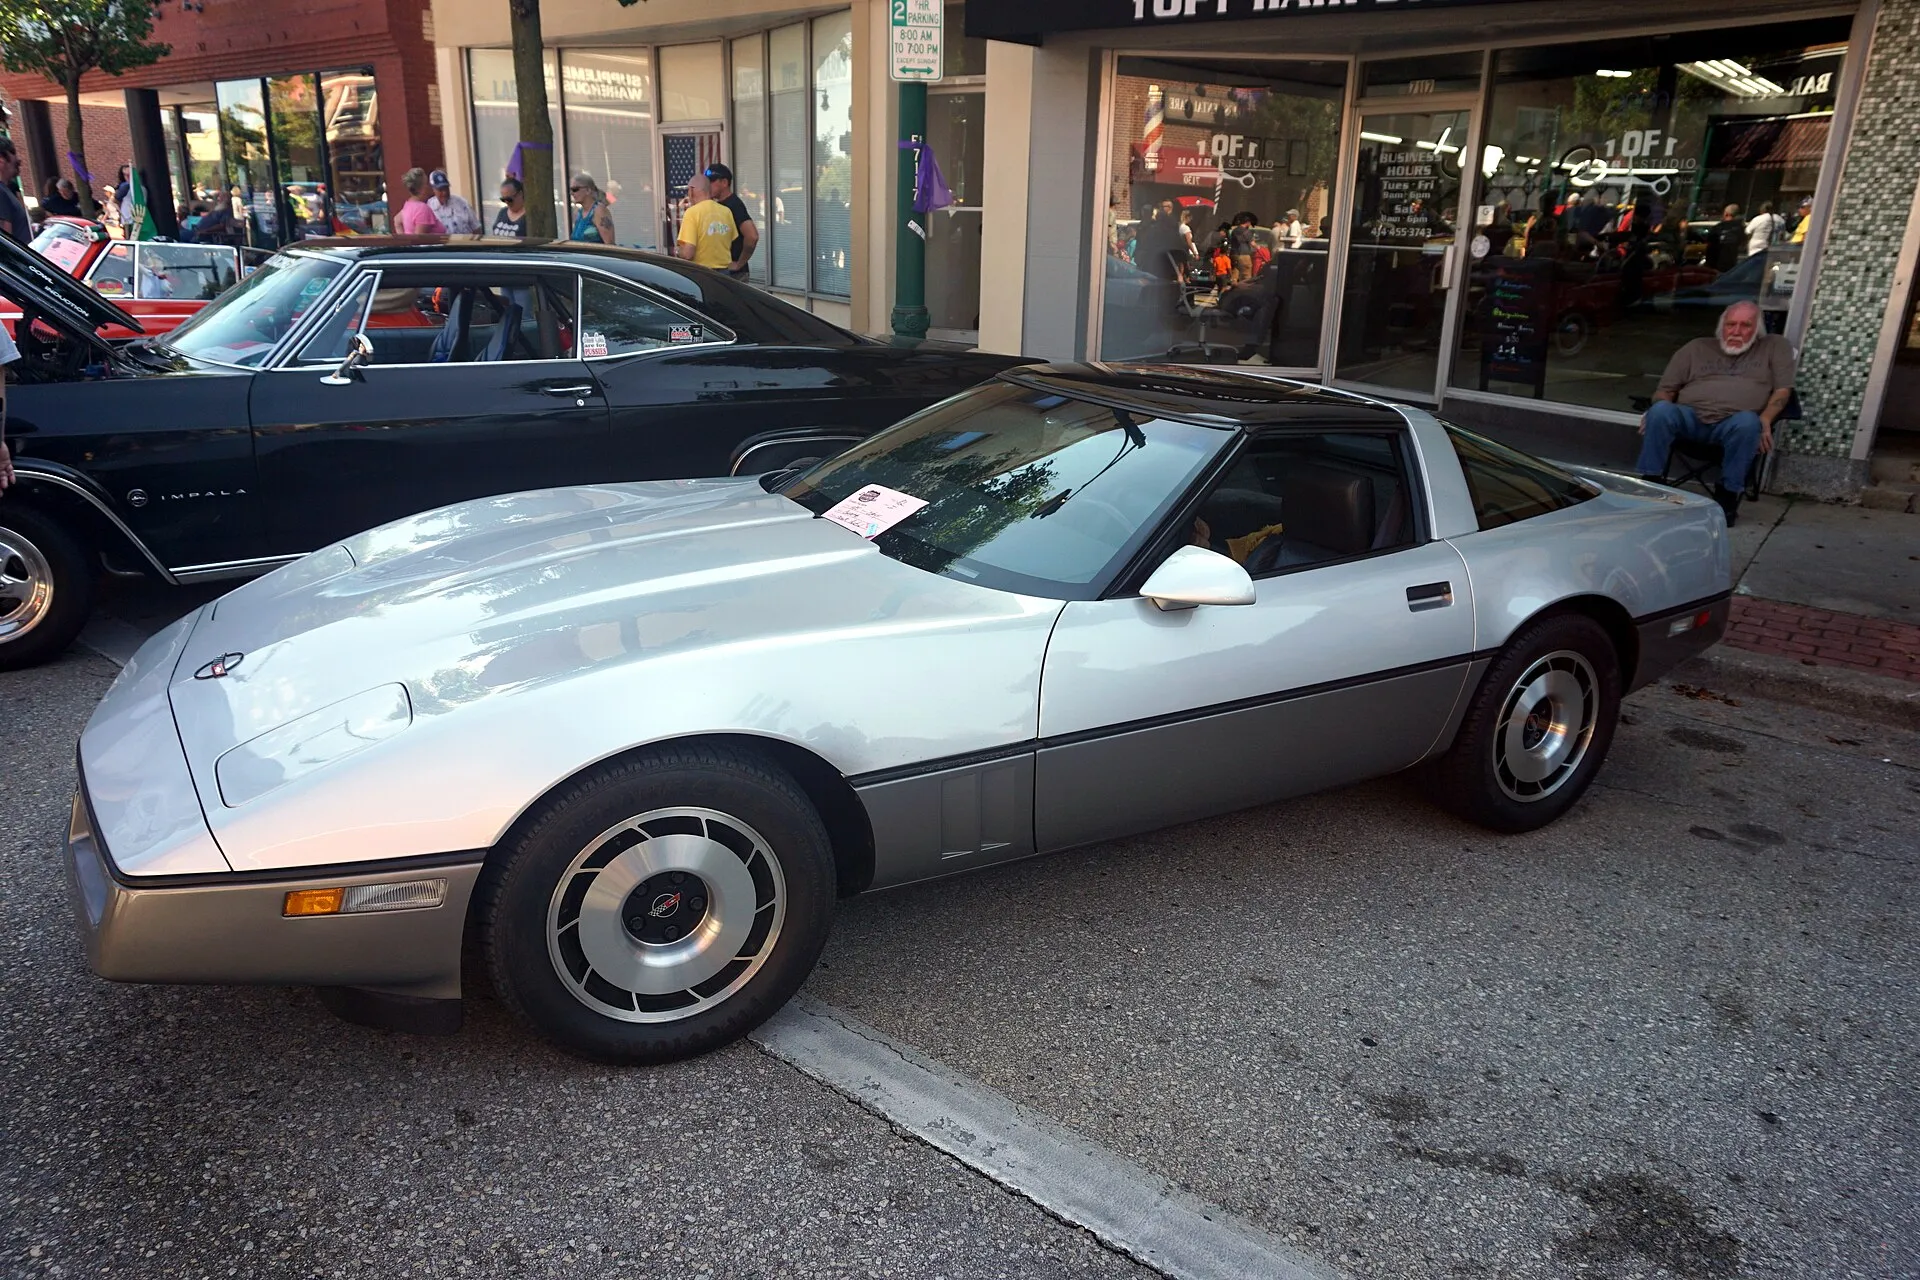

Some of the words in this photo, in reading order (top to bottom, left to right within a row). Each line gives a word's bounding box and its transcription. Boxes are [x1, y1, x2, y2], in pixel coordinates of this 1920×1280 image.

[893, 1, 905, 19] 2
[908, 12, 939, 24] PARKING
[900, 29, 918, 40] 8:00
[920, 30, 932, 40] AM
[894, 43, 904, 53] TO
[907, 43, 924, 53] 7:00
[927, 44, 938, 54] PM
[1177, 157, 1212, 167] HAIR
[1228, 159, 1274, 169] STUDIO
[1380, 151, 1442, 163] BUSINESS
[1640, 158, 1697, 169] STUDIO
[1387, 165, 1432, 176] HOURS
[1383, 181, 1409, 190] Tues
[1418, 180, 1434, 189] Fri
[28, 265, 54, 284] COWL
[44, 286, 90, 317] INDUCTION
[161, 488, 247, 501] IMPALA
